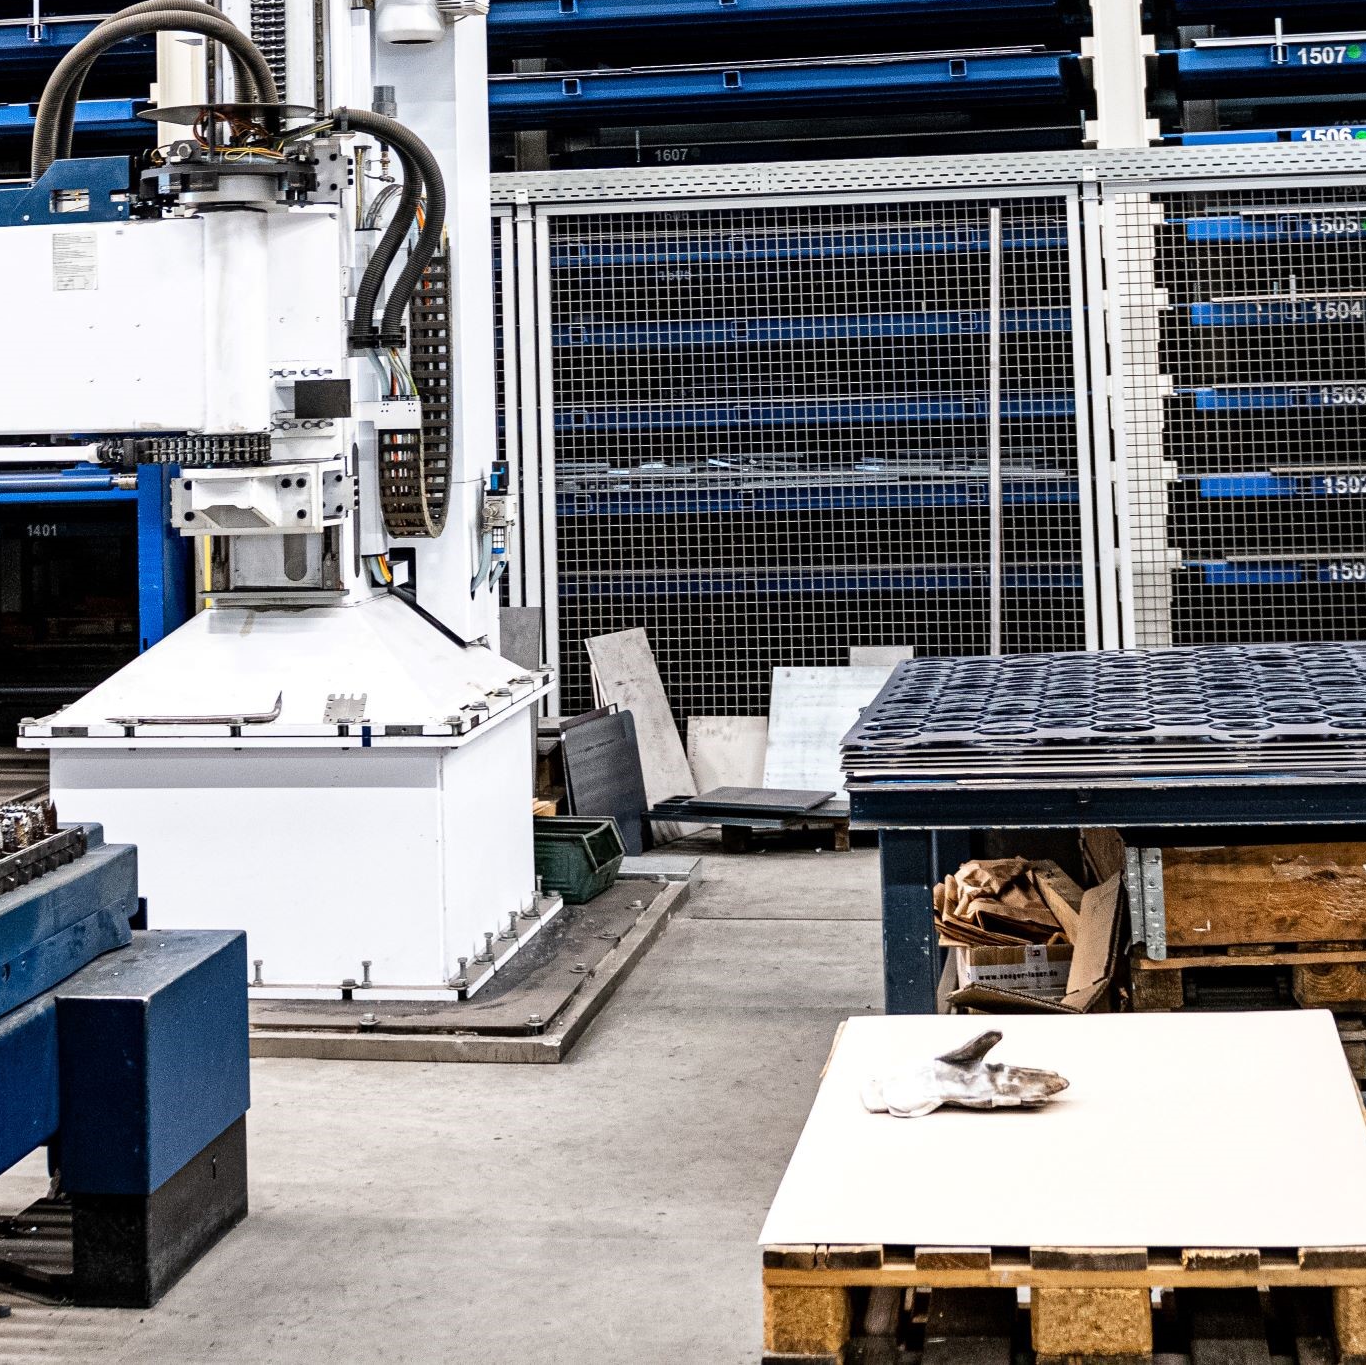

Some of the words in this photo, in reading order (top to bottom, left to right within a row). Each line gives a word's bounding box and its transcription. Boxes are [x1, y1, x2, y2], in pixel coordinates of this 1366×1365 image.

[1297, 46, 1347, 65] 1507
[1301, 127, 1353, 142] 1506
[654, 148, 688, 162] 1607
[1308, 216, 1358, 234] 1505
[1312, 301, 1363, 320] 1504
[26, 524, 57, 537] 1401
